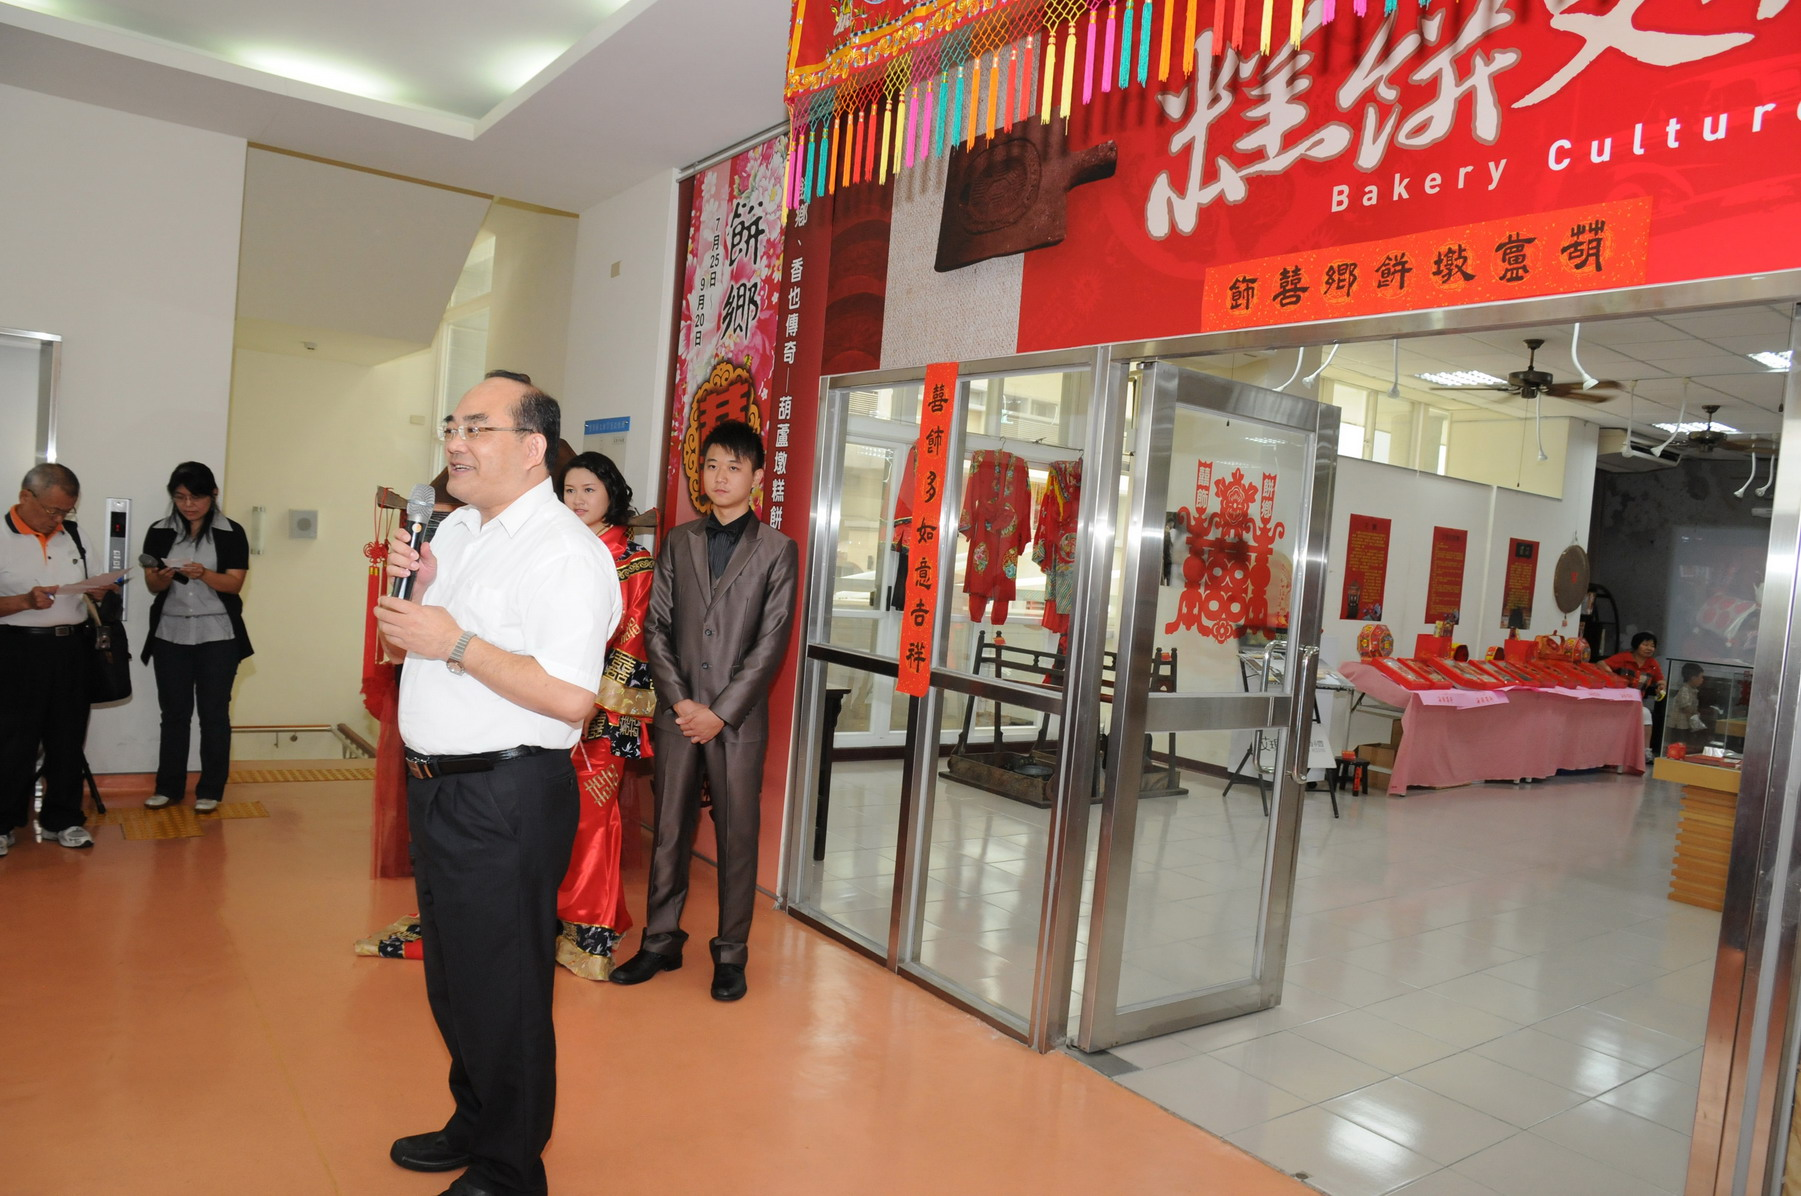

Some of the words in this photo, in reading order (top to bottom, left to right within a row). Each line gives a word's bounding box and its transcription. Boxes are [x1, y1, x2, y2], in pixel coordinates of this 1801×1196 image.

[1331, 156, 1510, 212] Bakery
[1547, 100, 1801, 171] Cultur
[694, 277, 706, 347] 9月20日
[721, 201, 765, 341] 餅鄉
